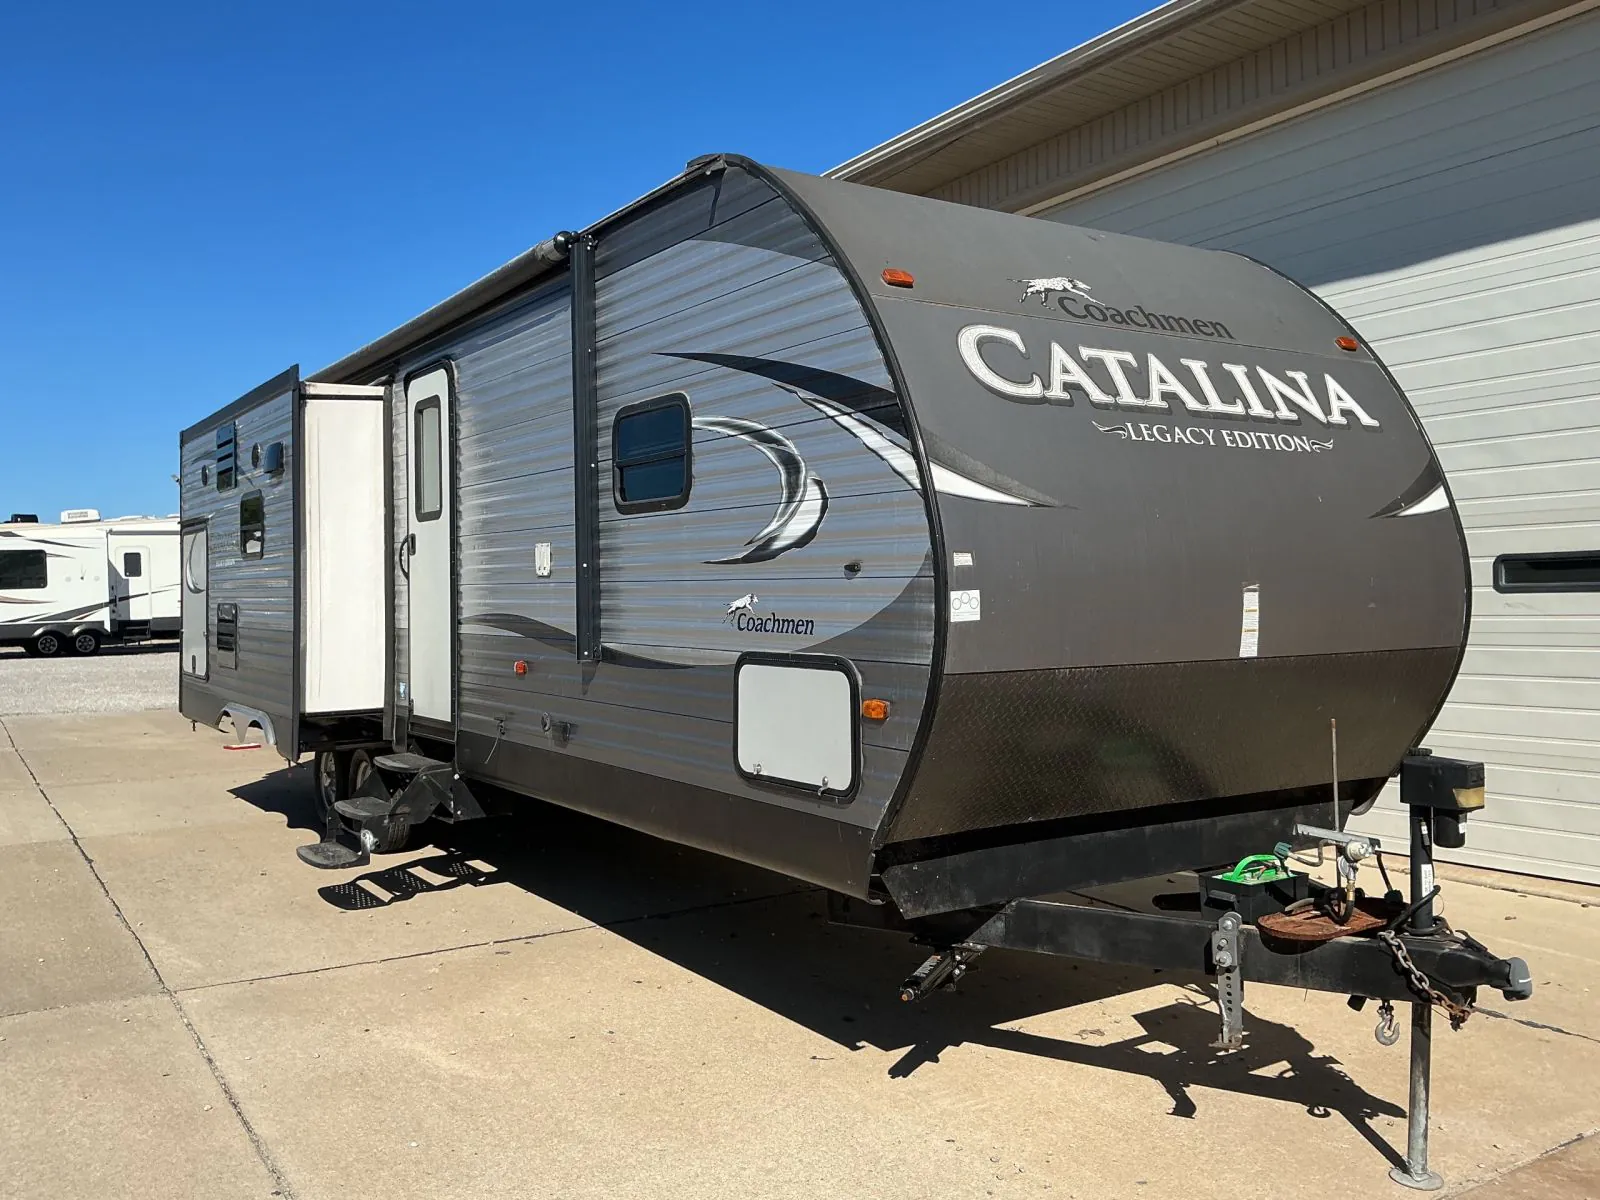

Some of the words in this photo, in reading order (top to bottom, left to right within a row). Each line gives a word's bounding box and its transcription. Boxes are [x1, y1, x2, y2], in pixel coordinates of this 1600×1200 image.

[1057, 296, 1234, 340] Coachmen
[956, 323, 1381, 428] CATALINA
[1125, 422, 1216, 447] LEGACY
[1225, 429, 1312, 454] EDITION
[737, 612, 815, 636] Coachmen
